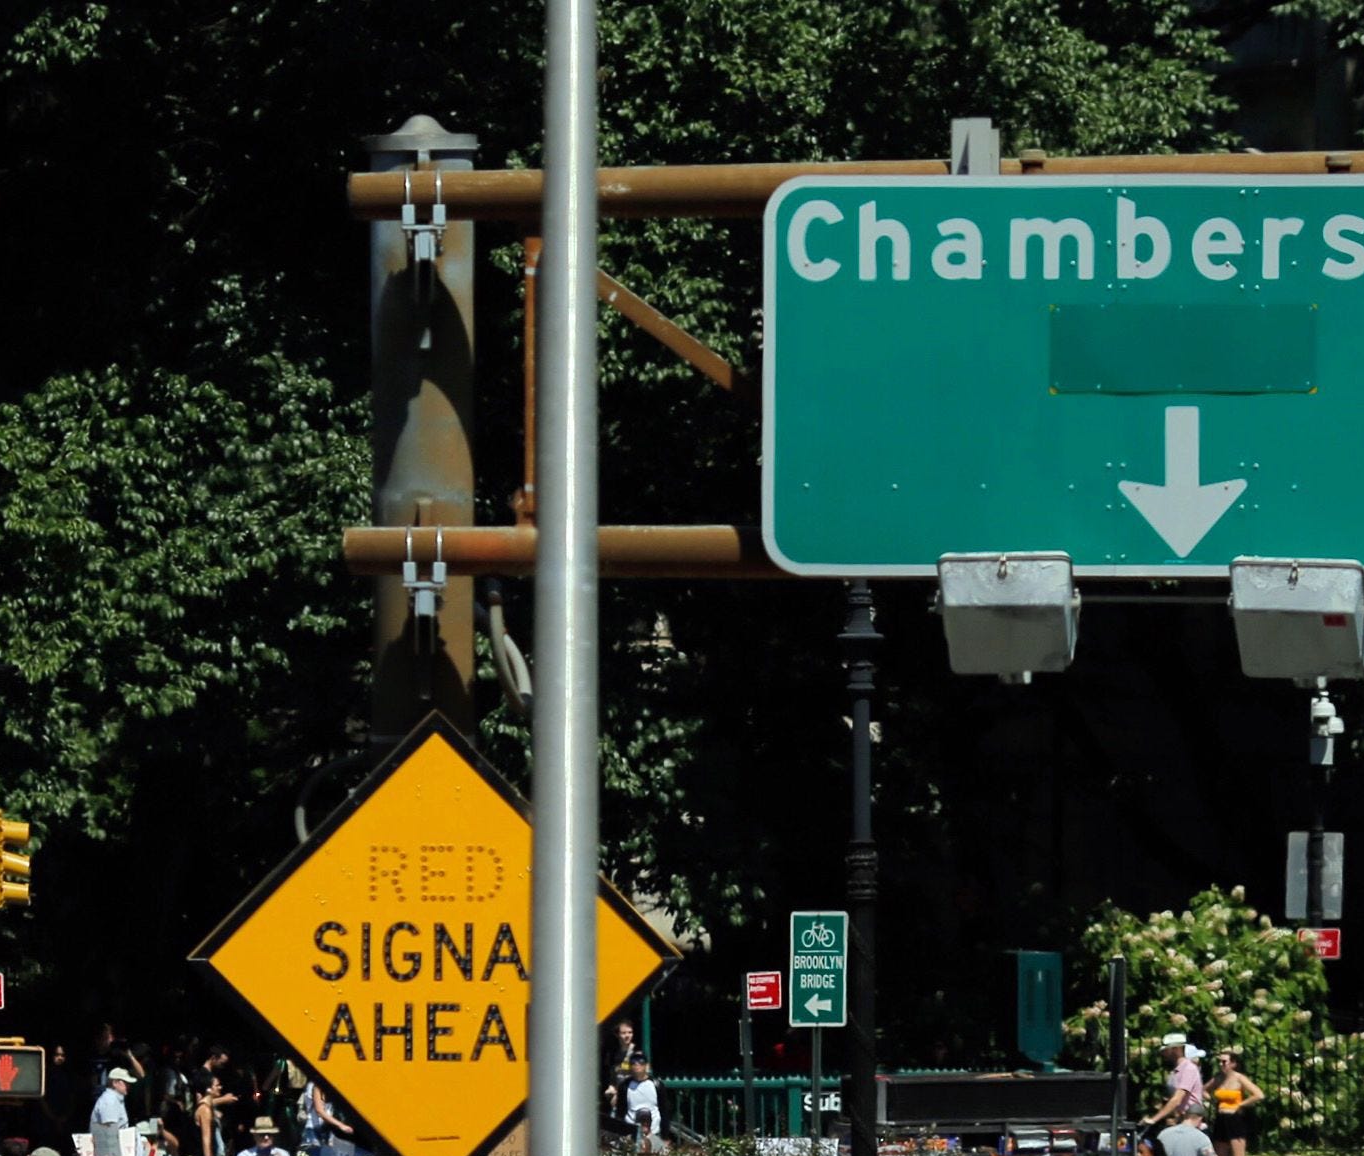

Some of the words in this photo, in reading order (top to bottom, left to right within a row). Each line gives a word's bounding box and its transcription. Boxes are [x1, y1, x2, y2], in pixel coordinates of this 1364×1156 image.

[368, 845, 504, 901] RED
[311, 921, 532, 982] SIGNA
[793, 956, 844, 970] BROOKLYN
[800, 975, 835, 989] BRIDGE
